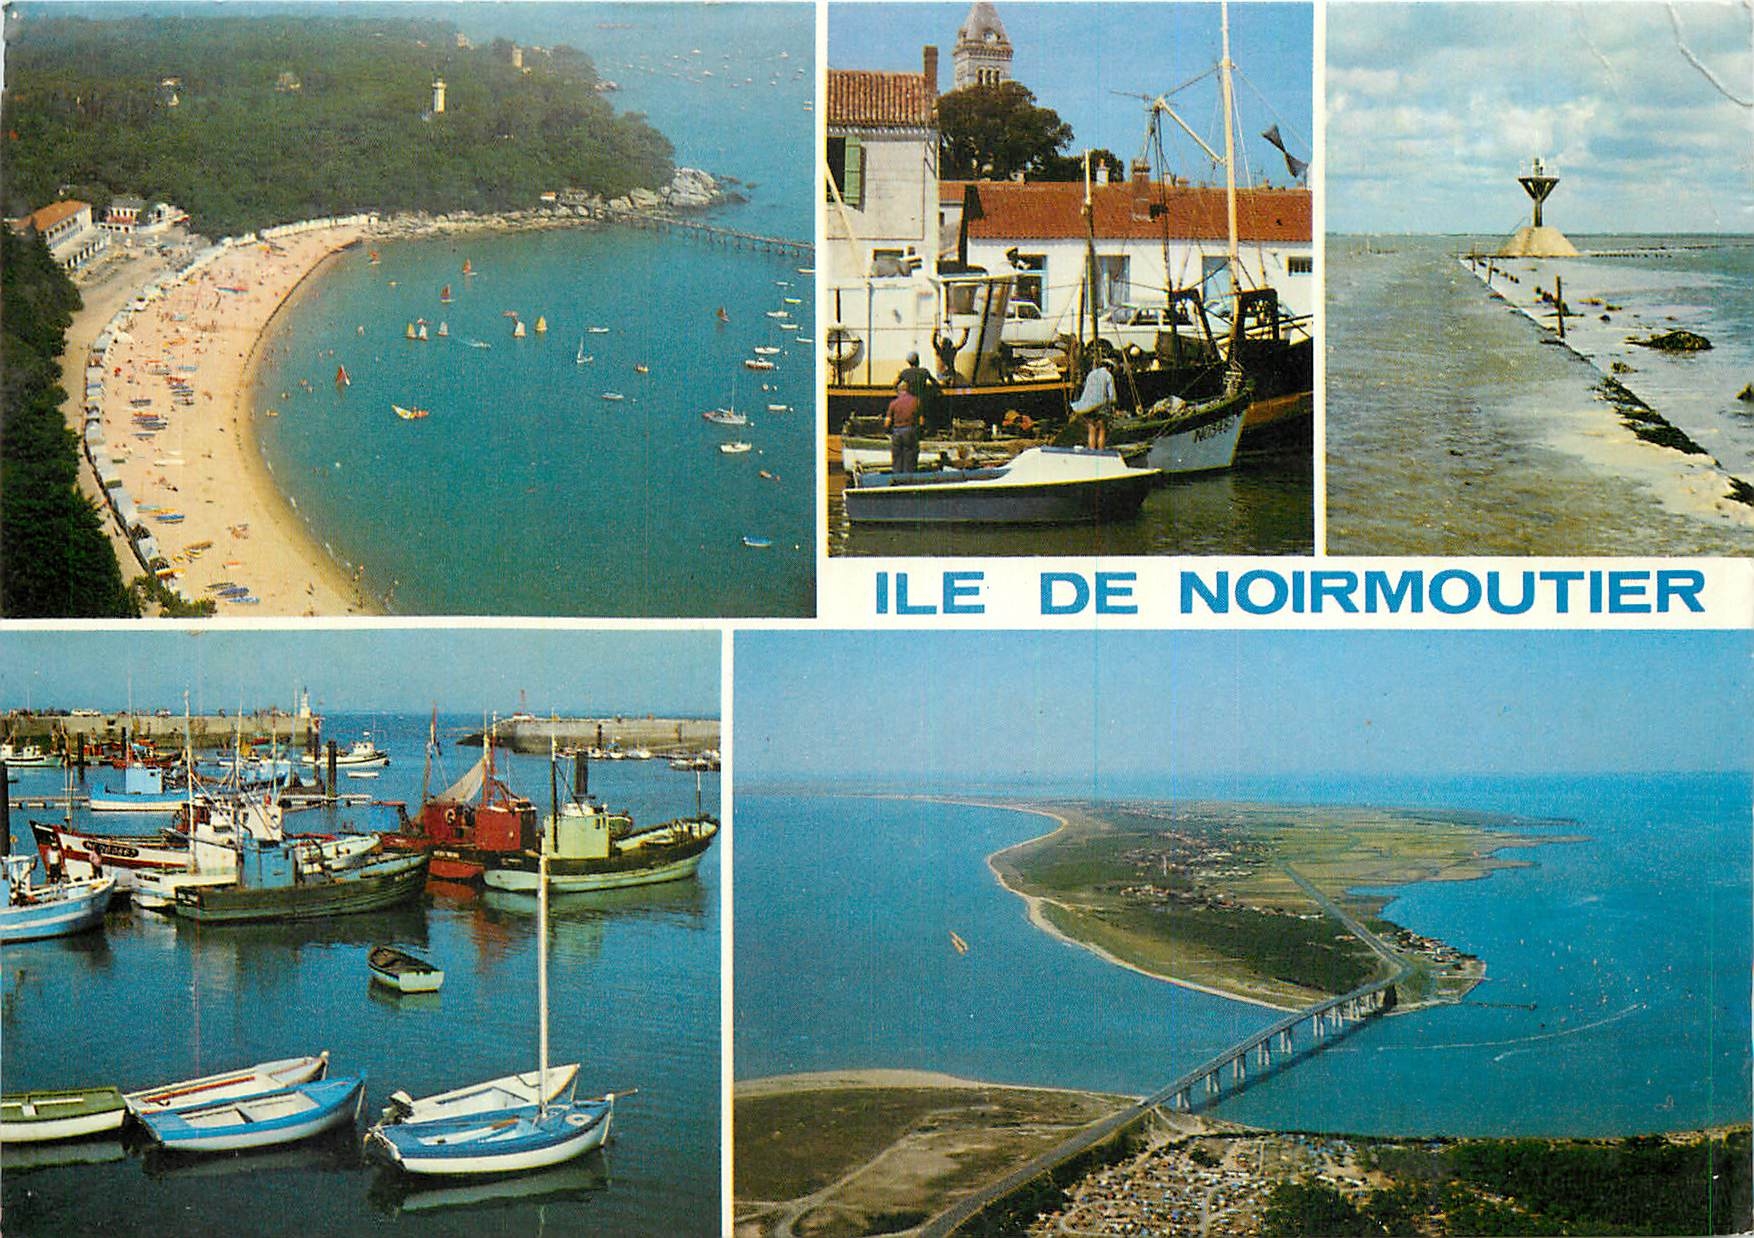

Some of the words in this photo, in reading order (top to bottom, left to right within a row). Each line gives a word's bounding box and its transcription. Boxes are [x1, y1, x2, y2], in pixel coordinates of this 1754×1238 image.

[875, 571, 986, 615] ILE
[1040, 571, 1138, 616] DE
[1180, 568, 1706, 615] NOIRMOUTIER
